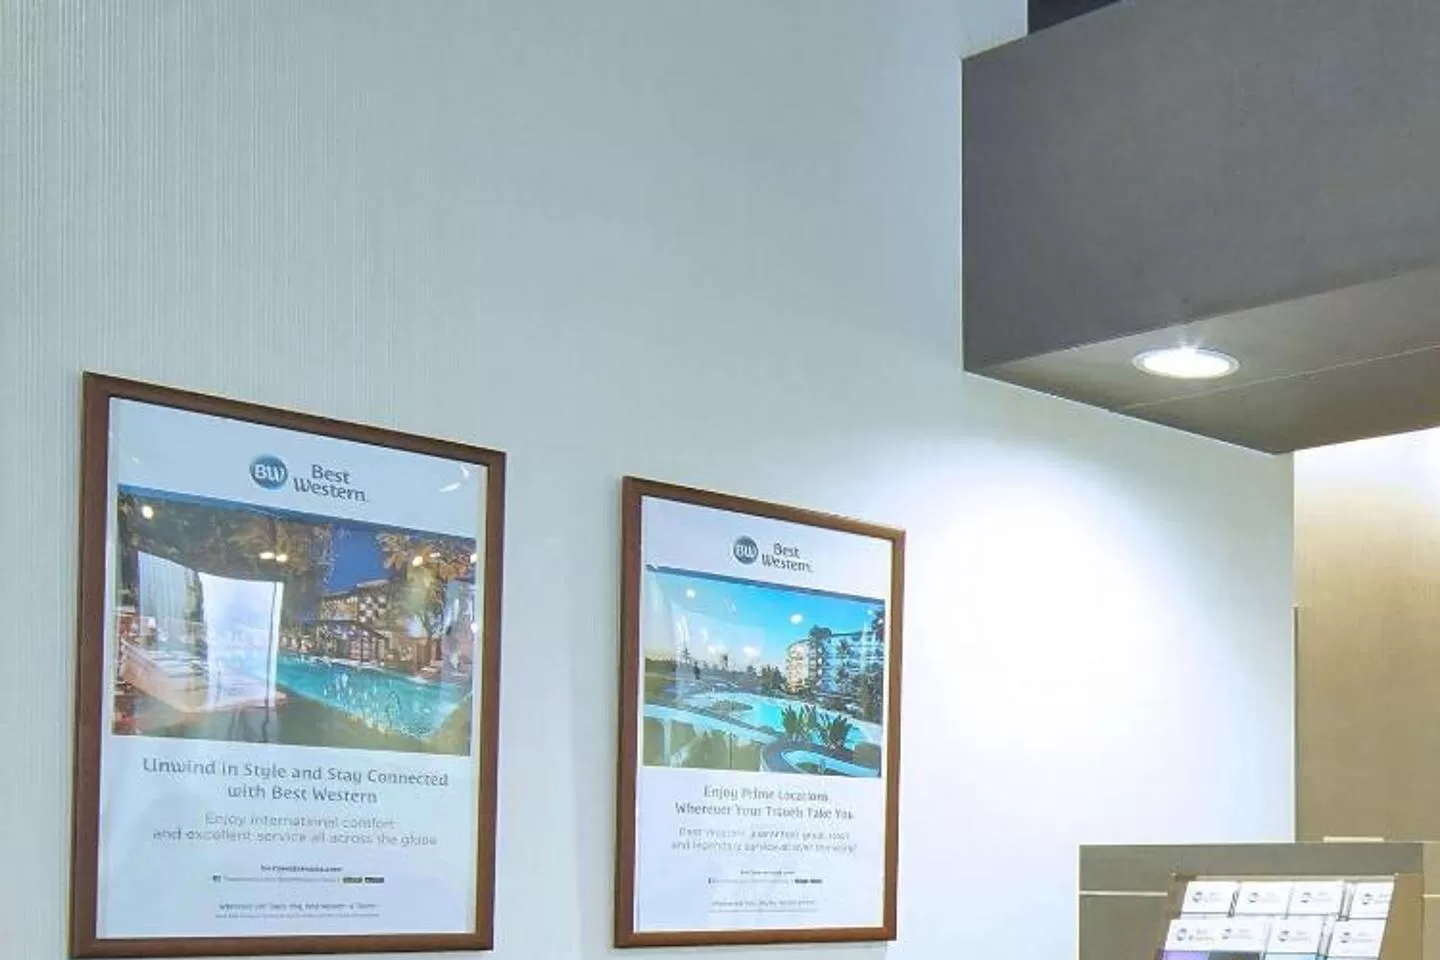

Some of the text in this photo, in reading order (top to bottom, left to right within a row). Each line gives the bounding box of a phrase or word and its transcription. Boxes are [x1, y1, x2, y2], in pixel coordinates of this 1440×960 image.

[311, 464, 351, 485] Best
[293, 477, 367, 502] Western
[773, 542, 801, 559] Best
[143, 757, 450, 787] Unwind in Style and Stay Connected
[227, 784, 378, 804] with Best Western
